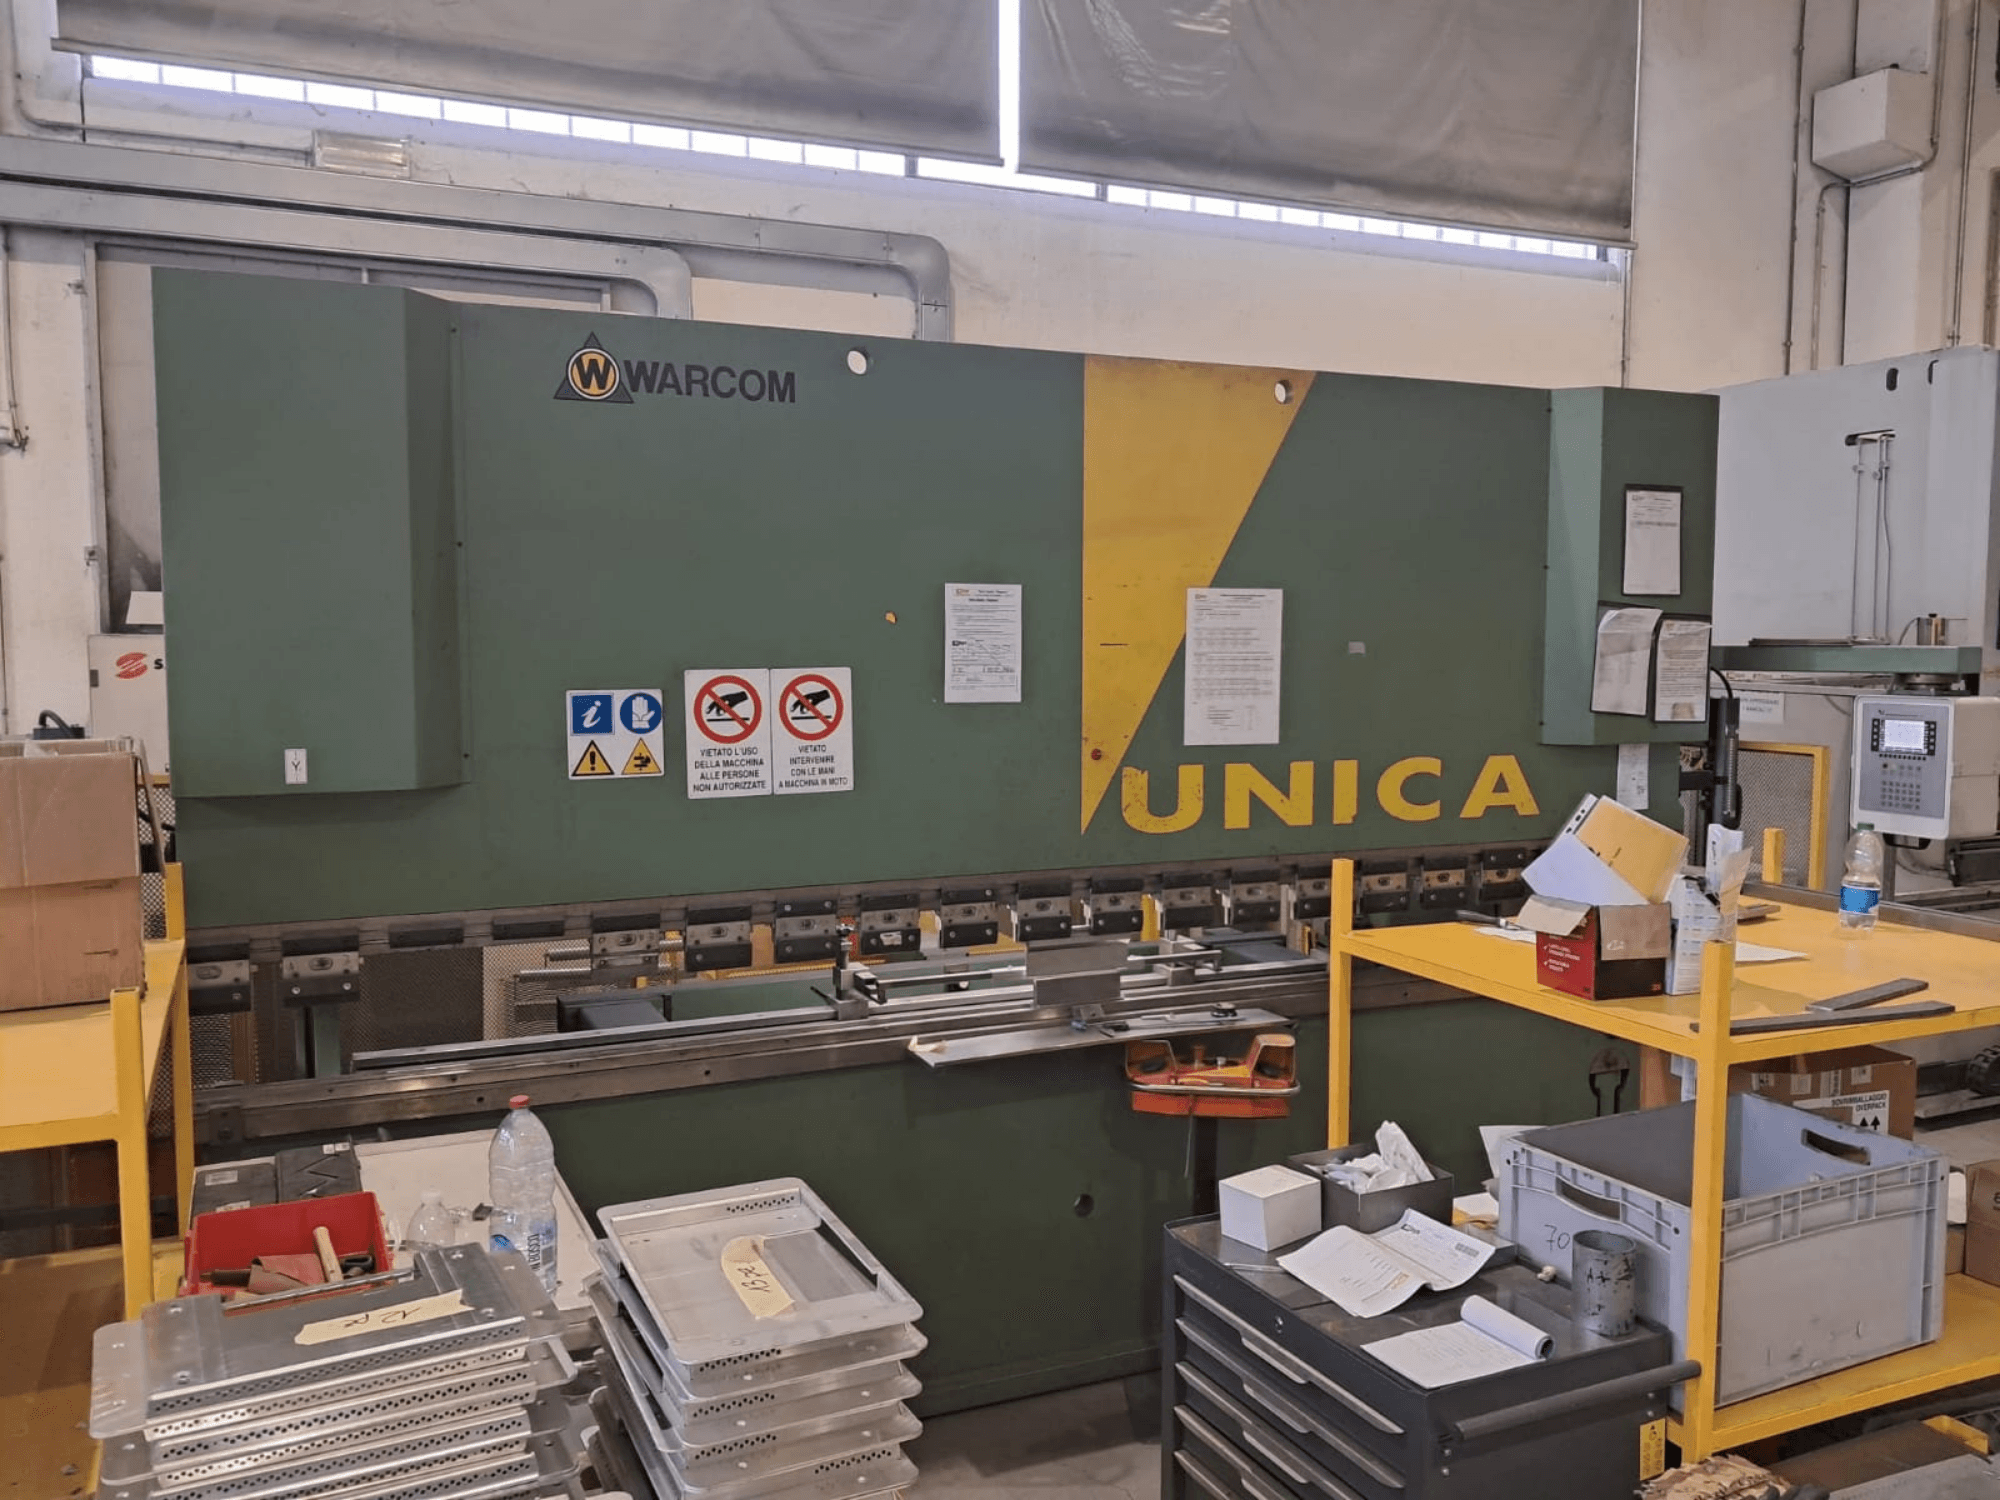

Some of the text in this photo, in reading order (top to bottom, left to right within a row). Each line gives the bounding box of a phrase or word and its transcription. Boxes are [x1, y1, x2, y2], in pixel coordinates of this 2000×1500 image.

[623, 359, 797, 403] WARCOM
[700, 747, 733, 757] VIETATO
[798, 744, 827, 753] VIETATO
[694, 758, 765, 770] DELLA MACCHINA
[789, 755, 835, 765] INTERVENIRE
[700, 769, 760, 780] ALLE PERSONE
[790, 766, 835, 777] CON LE MANI
[693, 780, 766, 792] NON AUTORIZZATE
[784, 779, 820, 788] MACCHINA
[820, 778, 828, 786] IN
[828, 777, 848, 786] MOTO
[1120, 754, 1541, 835] UNICA
[1543, 1224, 1571, 1253] 70
